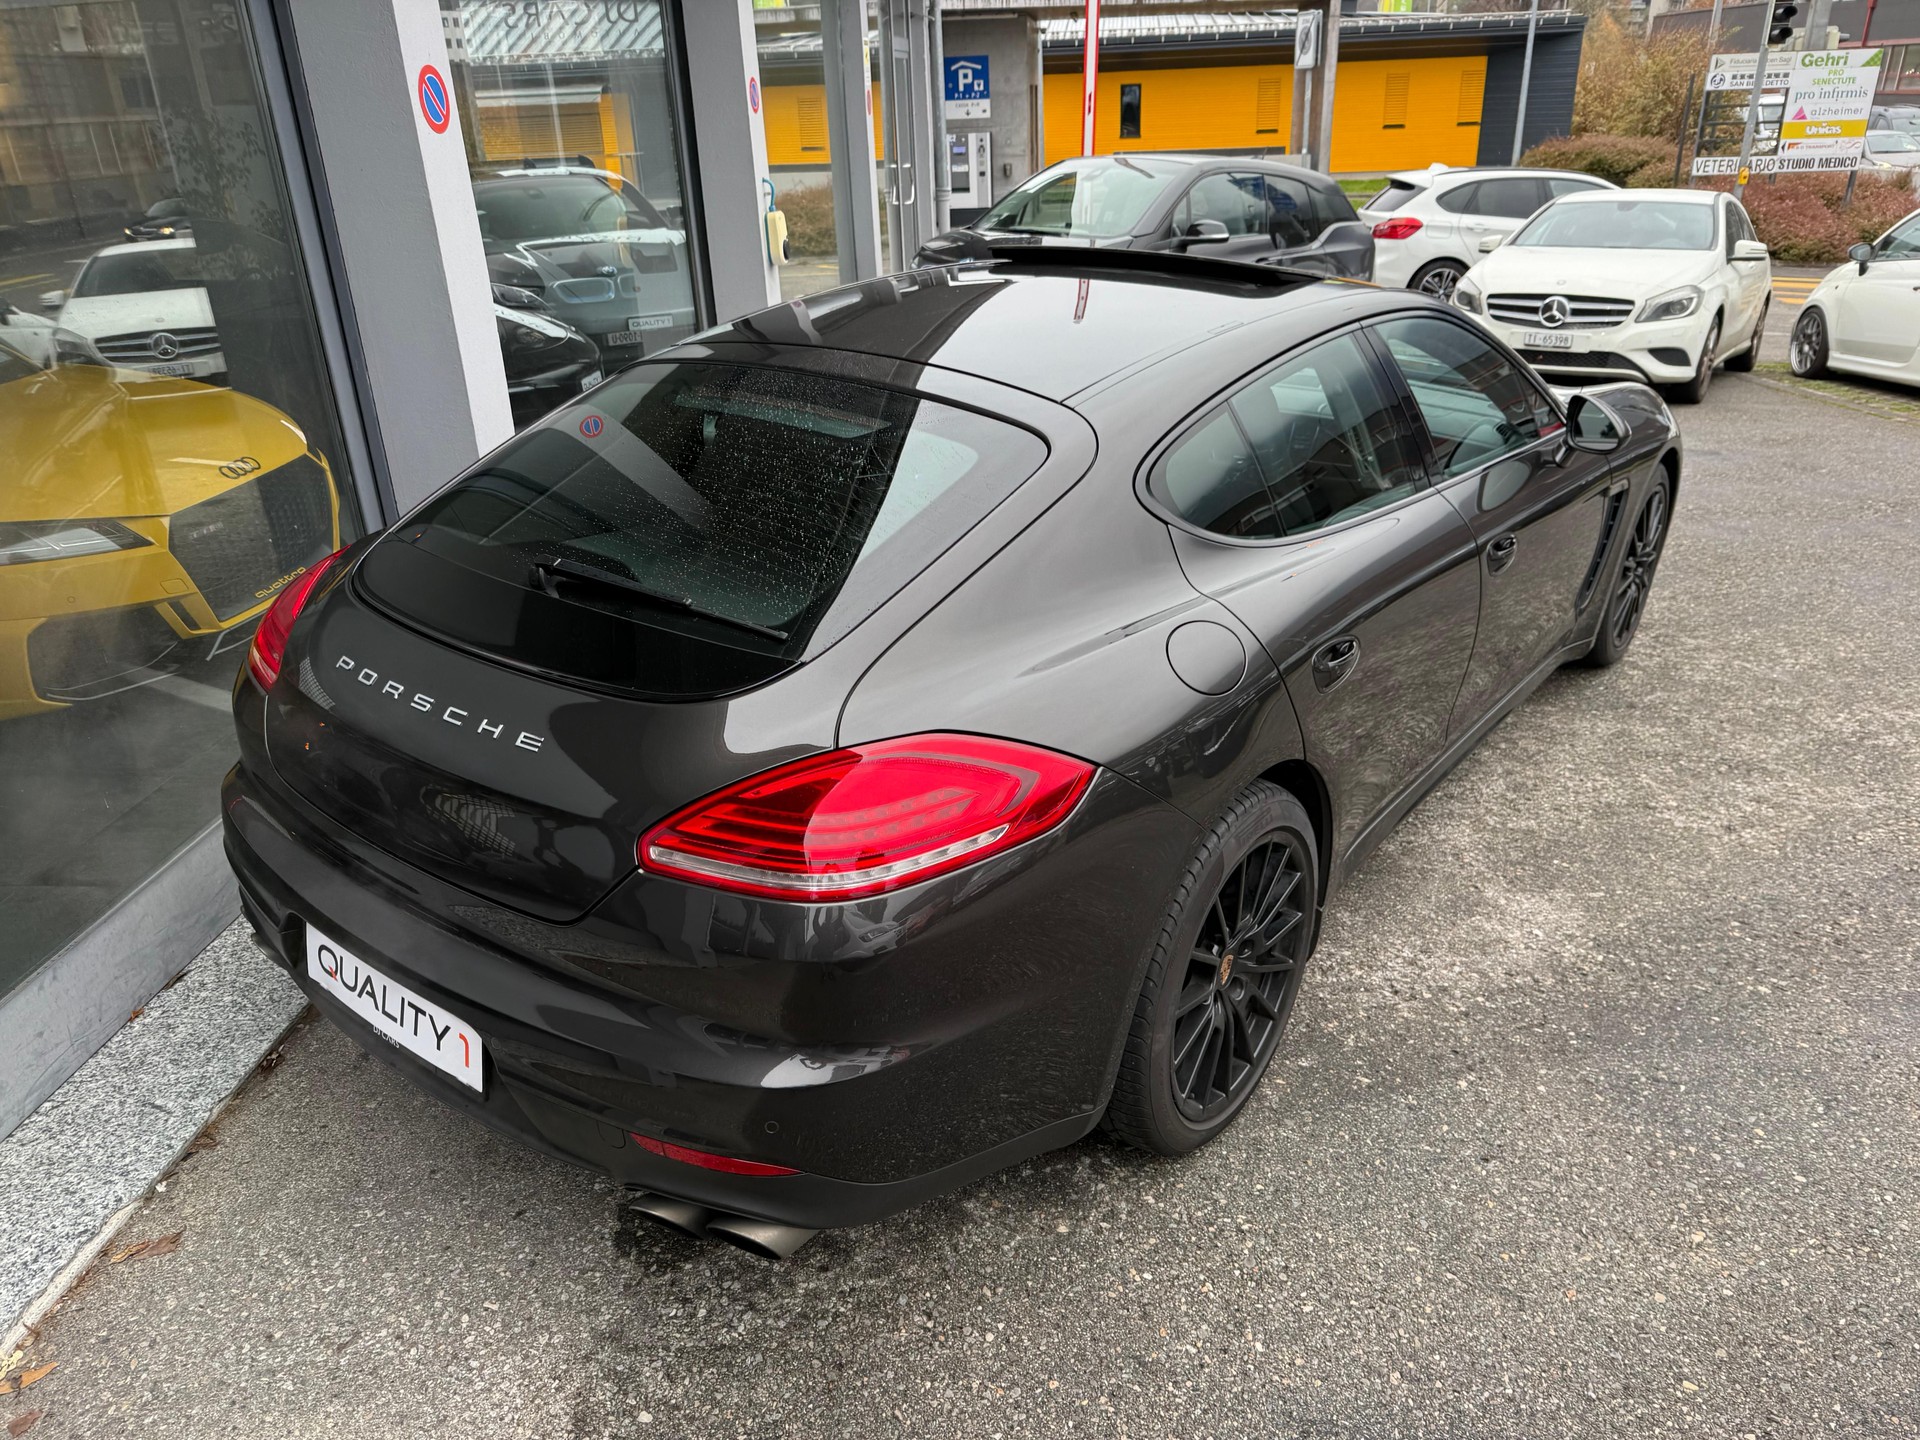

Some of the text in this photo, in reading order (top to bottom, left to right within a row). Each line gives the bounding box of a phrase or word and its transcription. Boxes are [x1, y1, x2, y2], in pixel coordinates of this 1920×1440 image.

[1801, 52, 1850, 68] Gehri
[1812, 76, 1857, 86] SENECTUTE
[1828, 69, 1845, 77] PRO
[1730, 80, 1744, 88] SAN
[1794, 86, 1869, 103] pro infirmis
[1811, 106, 1864, 117] alzheimer
[1695, 157, 1776, 173] VETERIARIO
[1778, 156, 1858, 170] STUDIO MEDICO
[255, 566, 306, 599] quattro
[335, 655, 545, 752] PORSCHE
[317, 944, 451, 1052] QUALITY
